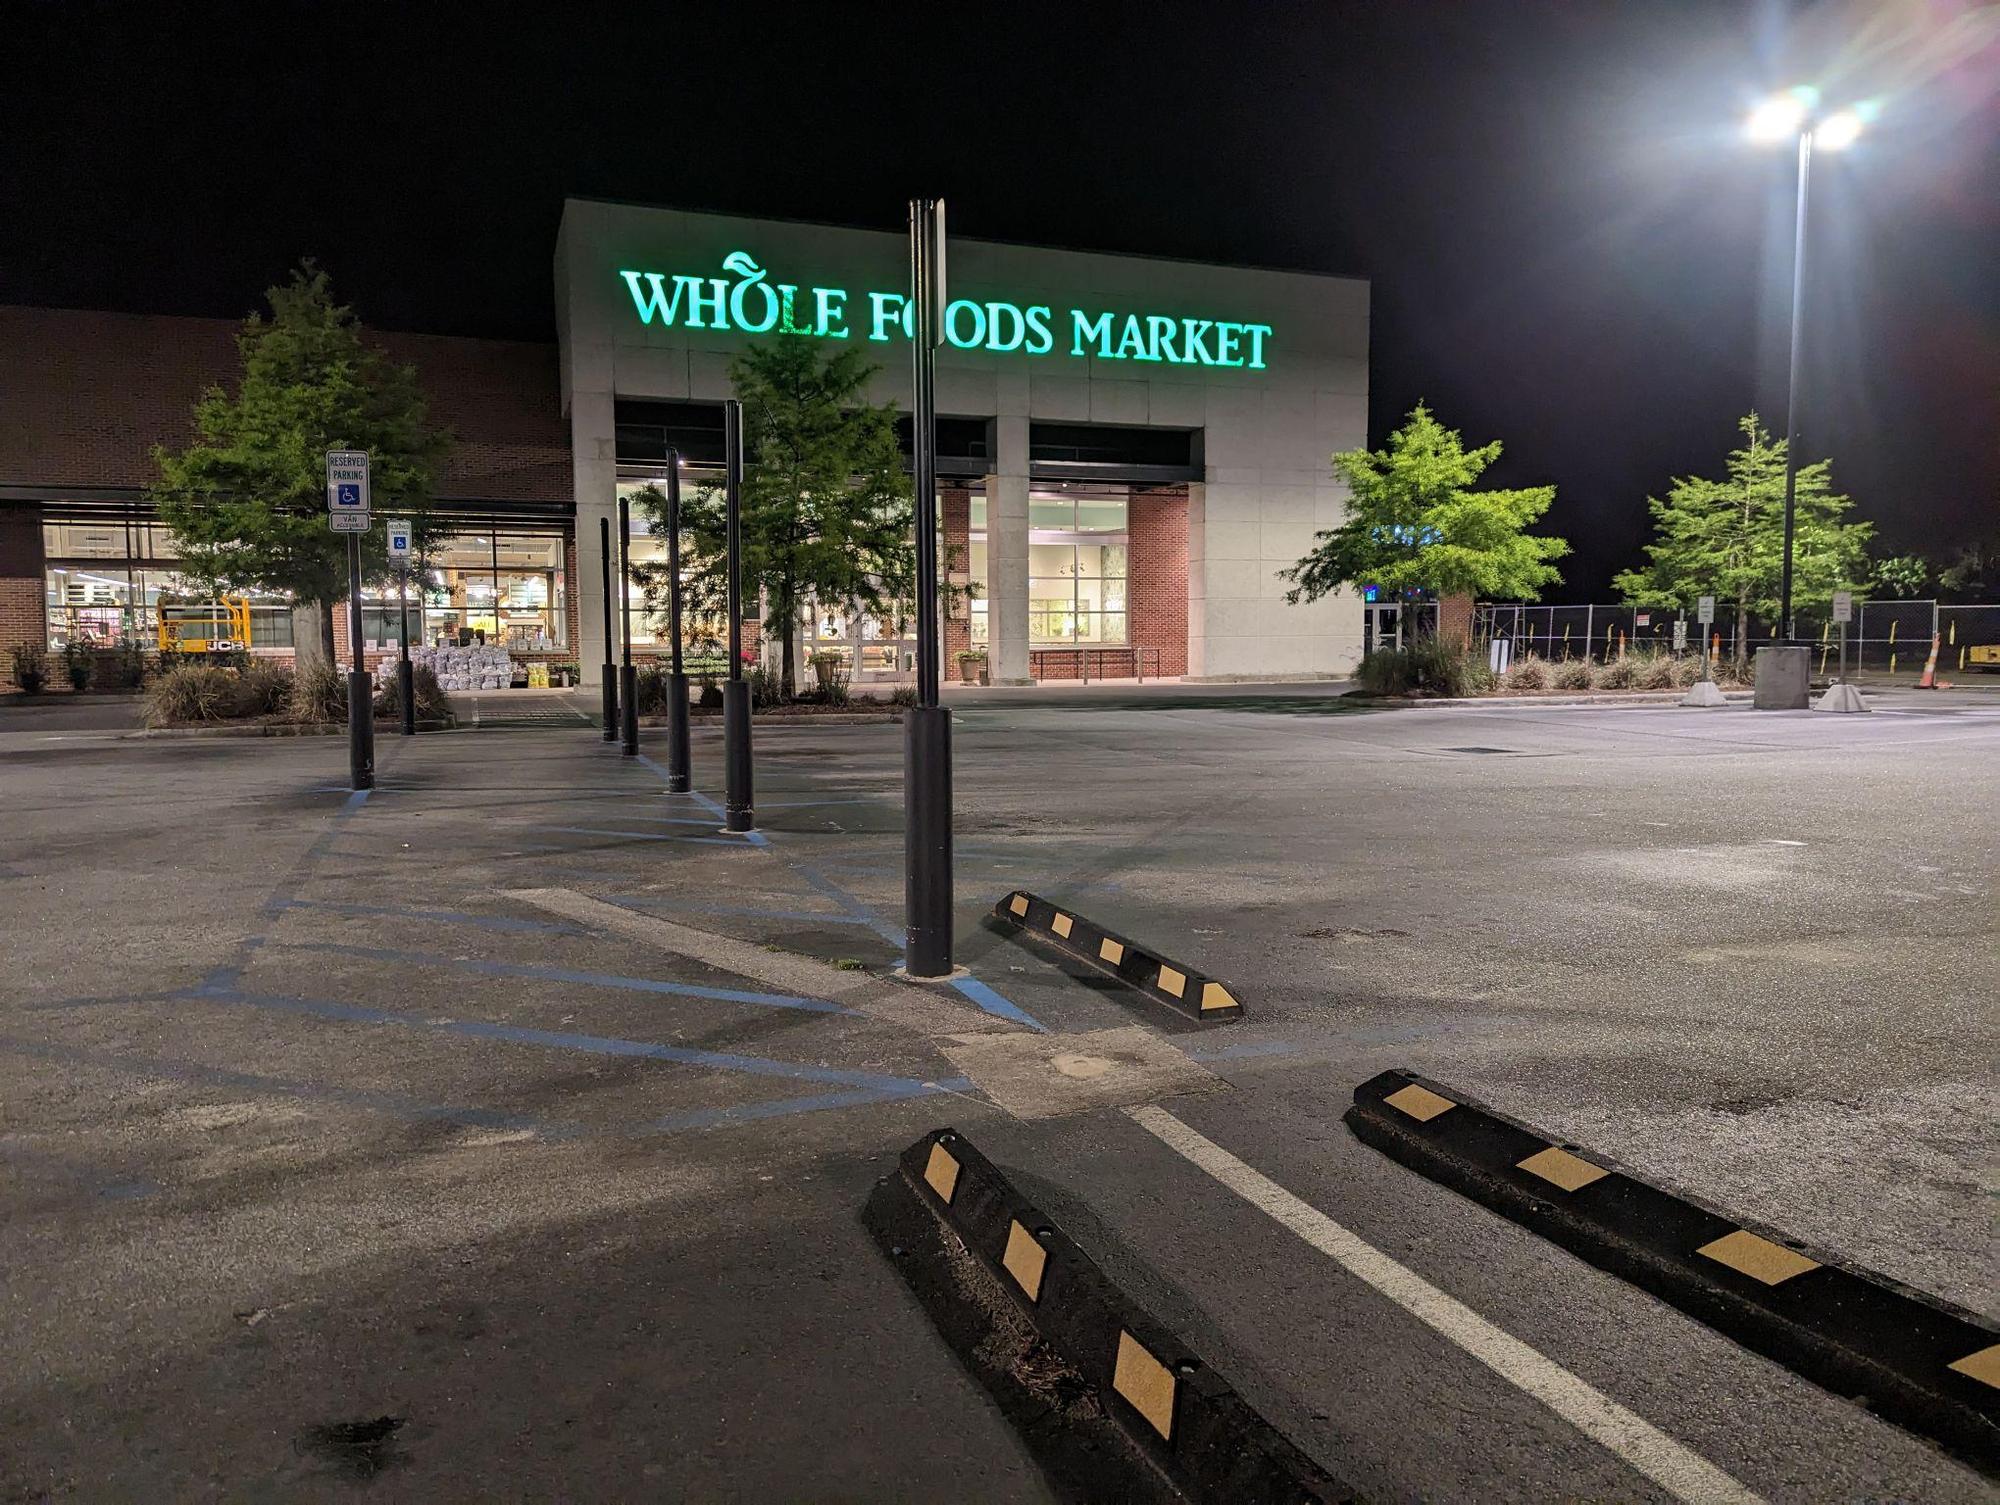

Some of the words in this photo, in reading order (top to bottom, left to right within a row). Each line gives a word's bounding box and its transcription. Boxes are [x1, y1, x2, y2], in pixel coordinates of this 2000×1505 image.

[619, 251, 848, 338] WHOLE
[868, 293, 1053, 353] FODS
[1071, 310, 1272, 368] MARKET
[330, 457, 366, 466] RESERVED
[333, 471, 363, 480] PARKING
